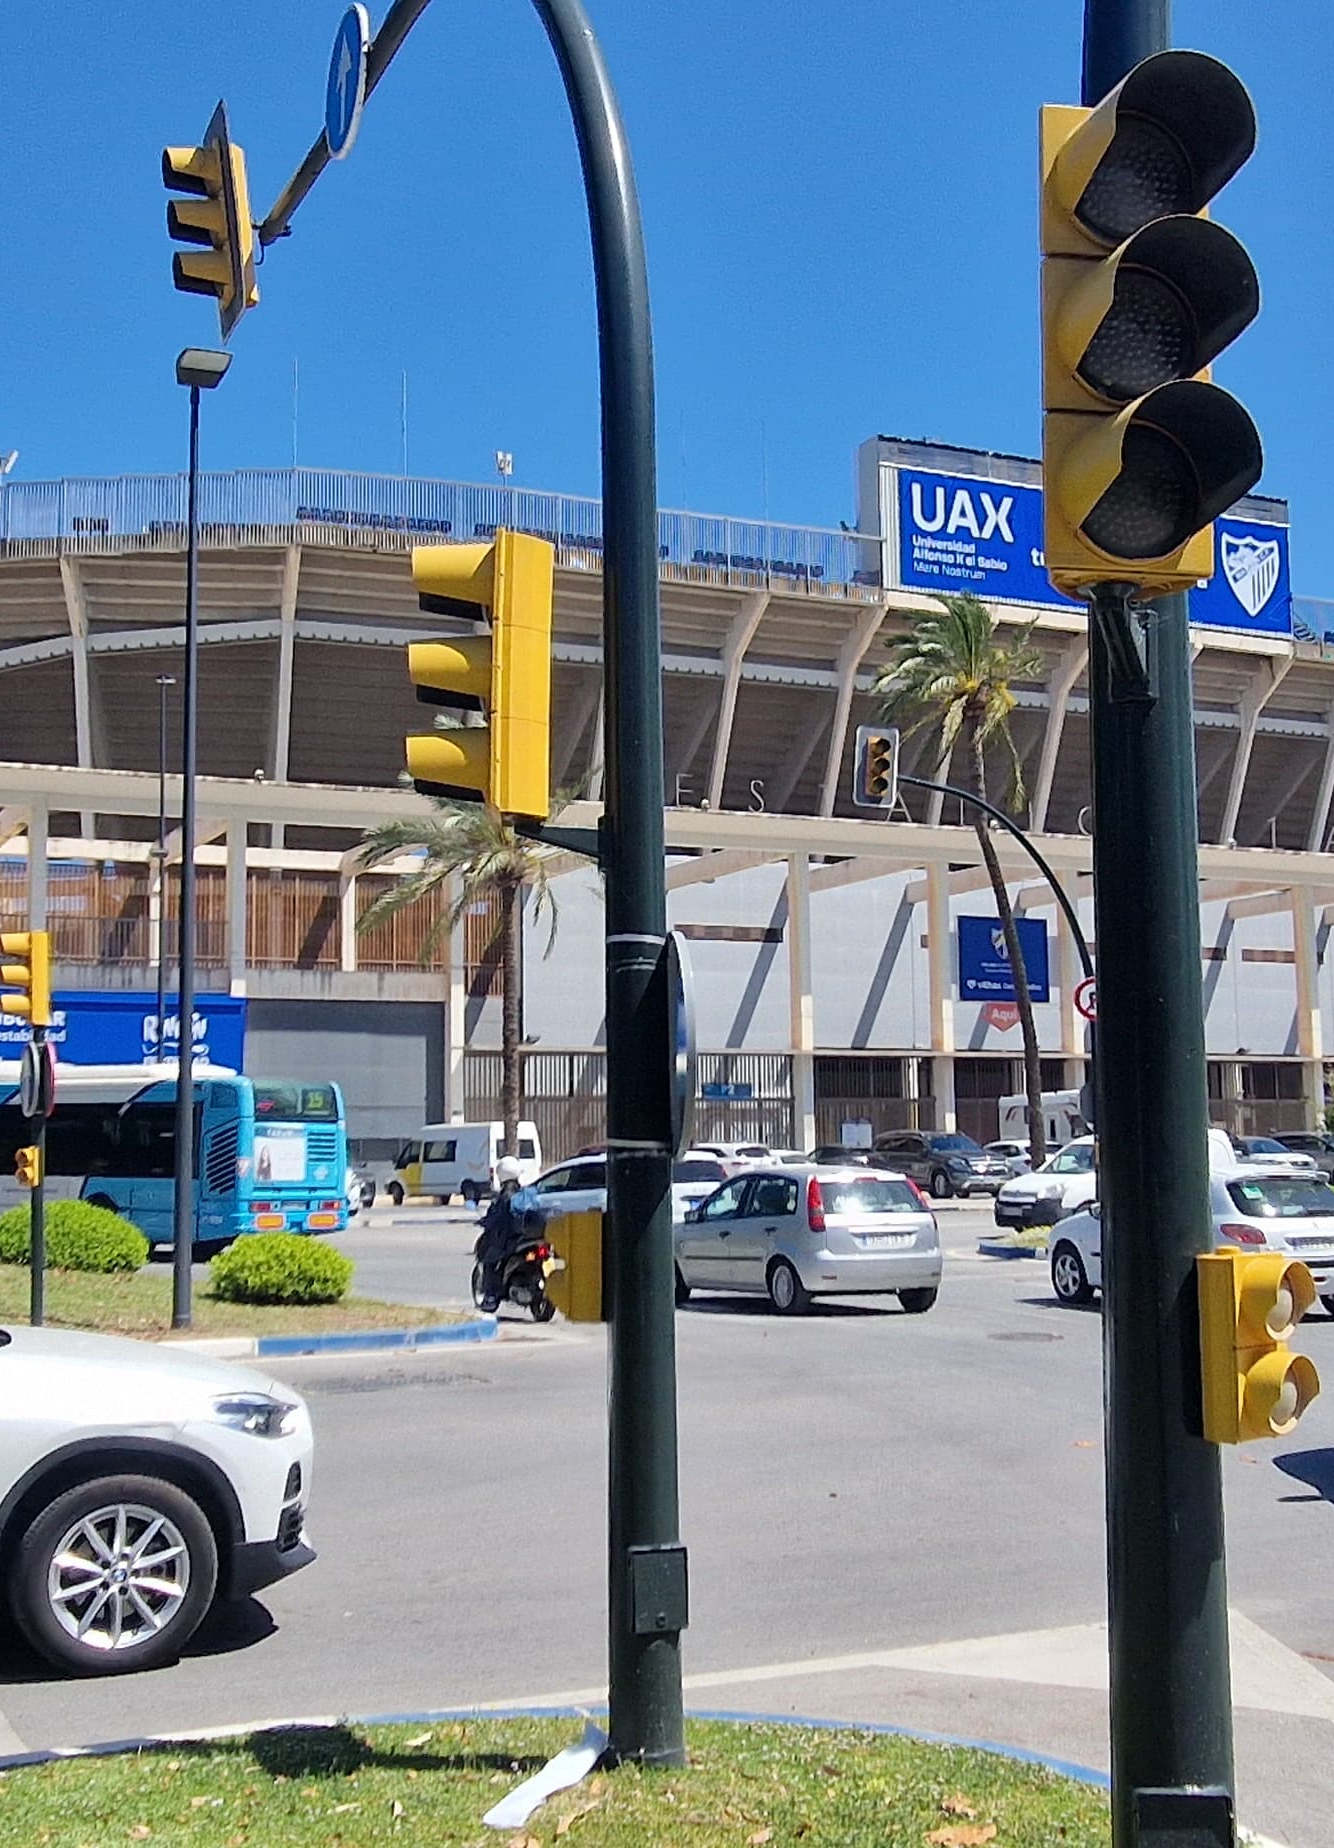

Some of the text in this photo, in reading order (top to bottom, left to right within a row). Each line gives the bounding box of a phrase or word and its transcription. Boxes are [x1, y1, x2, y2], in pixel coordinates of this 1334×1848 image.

[911, 482, 1014, 543] UAX
[912, 534, 976, 554] Universidad
[913, 548, 955, 564] Alfonso
